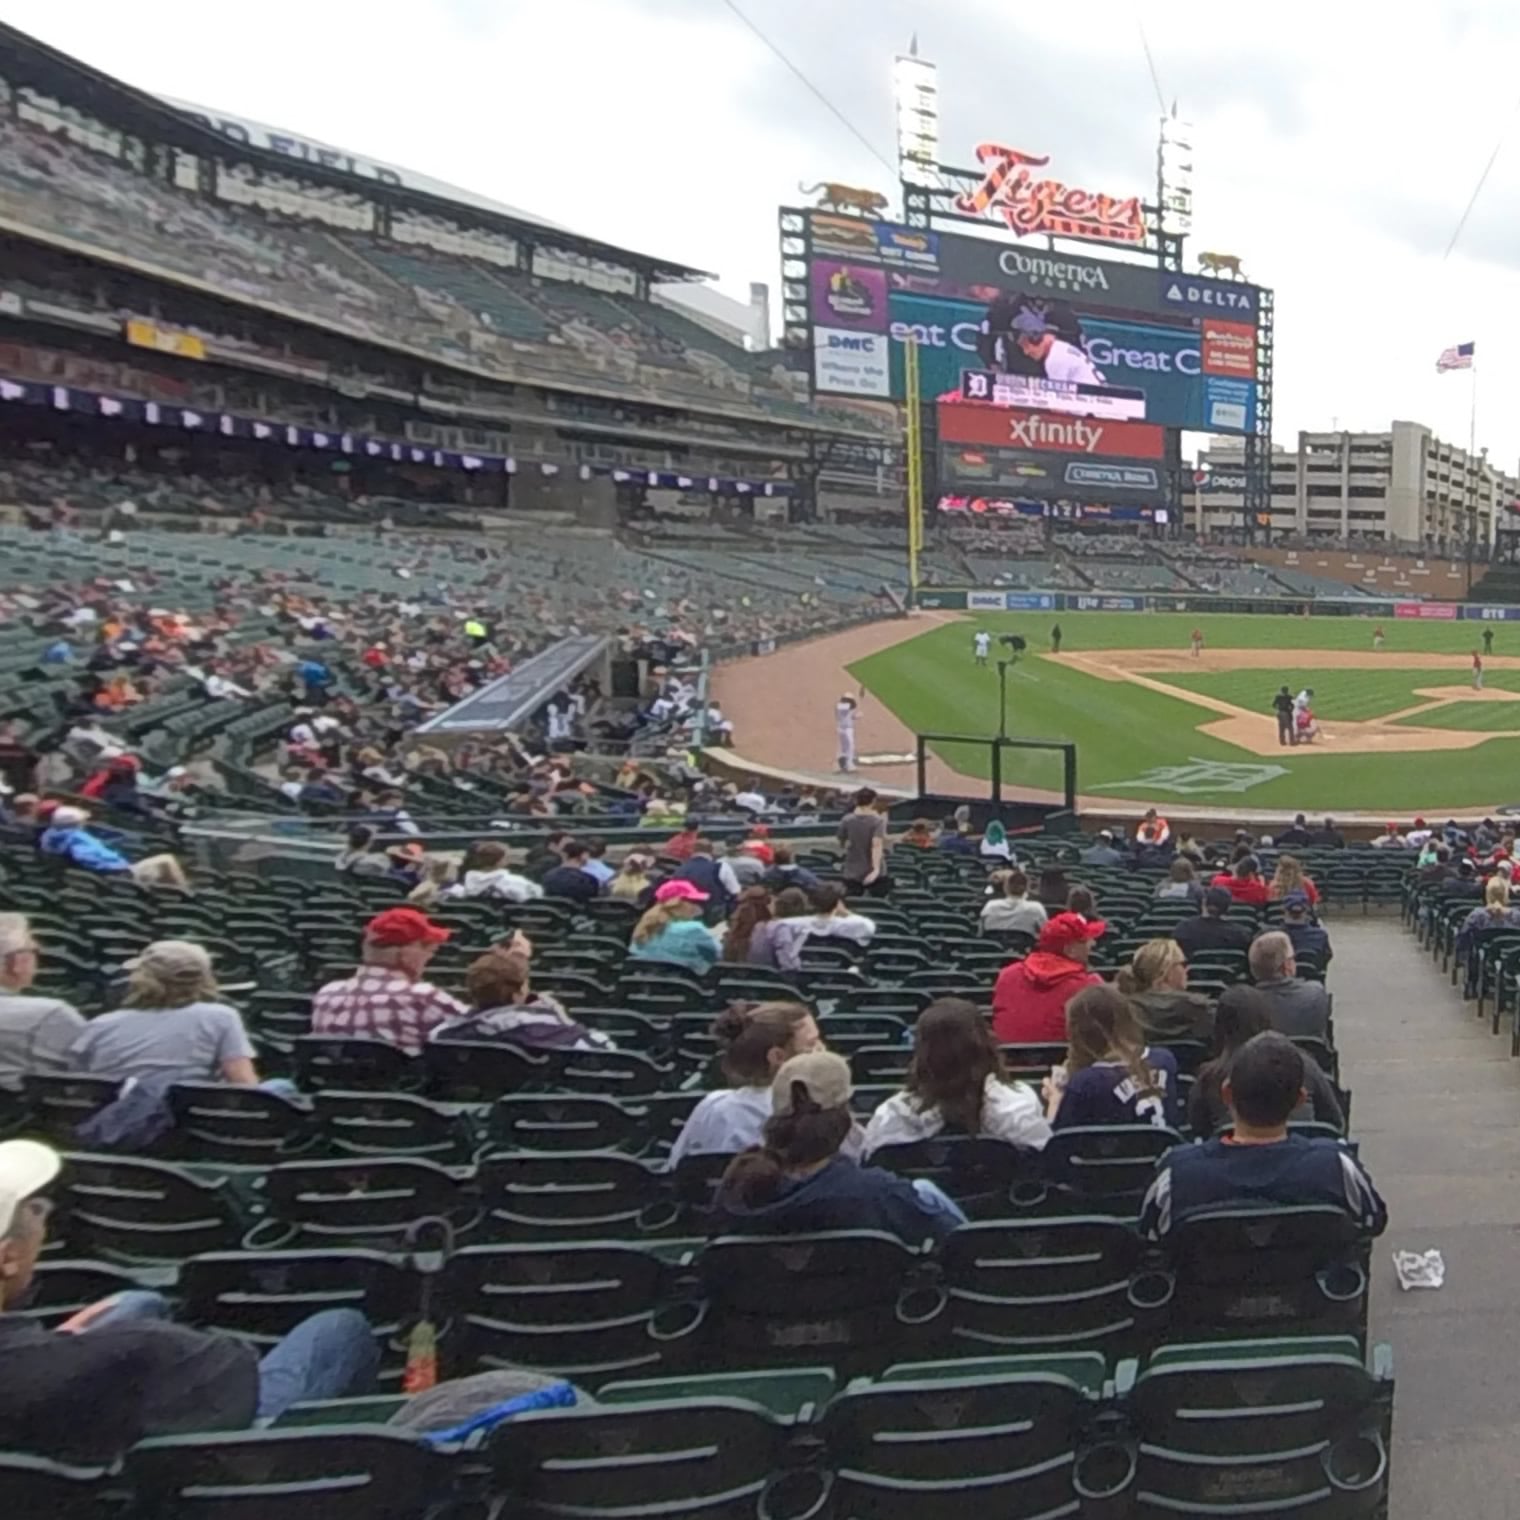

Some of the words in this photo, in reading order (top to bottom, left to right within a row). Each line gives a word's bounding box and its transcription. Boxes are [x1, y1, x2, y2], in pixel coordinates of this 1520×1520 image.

[953, 143, 1143, 232] Tigers
[1187, 286, 1250, 309] DELTA
[828, 334, 874, 352] DMC
[1087, 339, 1171, 372] Great
[1010, 415, 1103, 453] xfinity
[1212, 475, 1247, 488] pepsi
